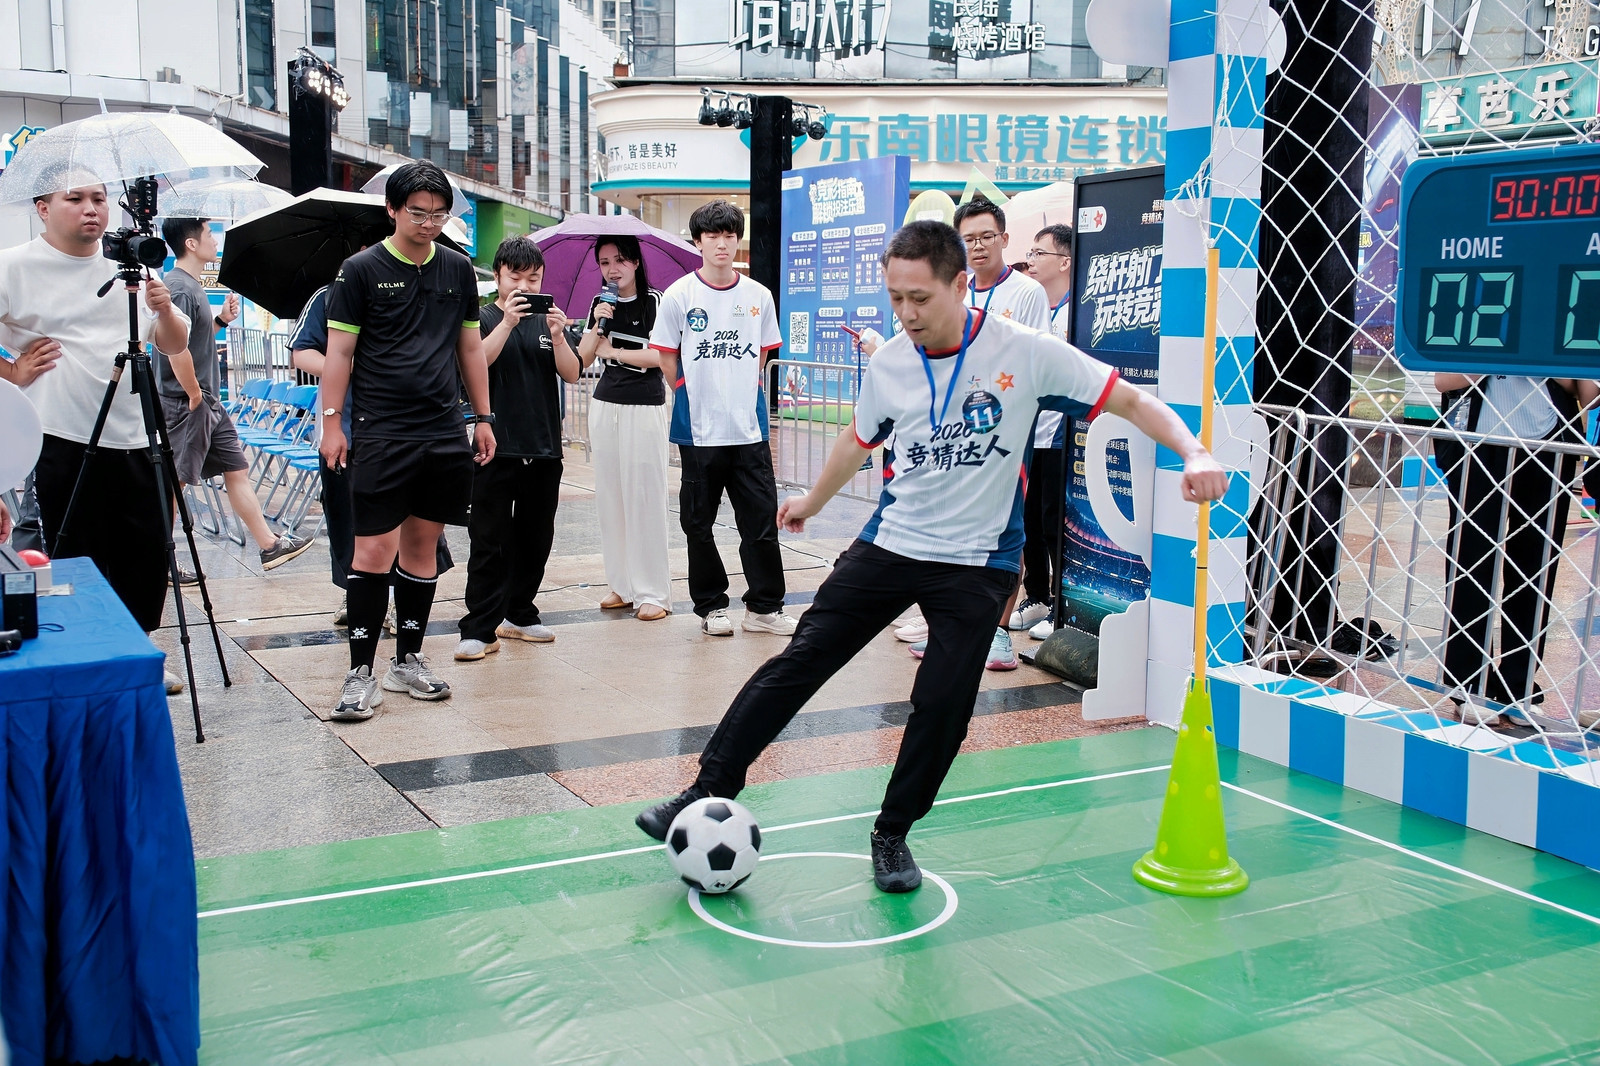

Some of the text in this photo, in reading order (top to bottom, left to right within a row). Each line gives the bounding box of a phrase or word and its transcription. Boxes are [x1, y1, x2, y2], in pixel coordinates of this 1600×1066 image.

[951, 22, 1045, 51] 烧烤酒馆
[1423, 70, 1574, 133] 草芭乐
[819, 113, 1167, 164] 东南眼镜连锁
[648, 161, 678, 170] BEAUTY
[1494, 173, 1600, 220] 90:00
[1441, 236, 1503, 260] HOME
[378, 281, 405, 289] KELME
[1425, 272, 1515, 347] 02
[690, 317, 705, 329] 20
[713, 330, 739, 342] 2026
[693, 339, 758, 361] 竞猜达人
[970, 406, 995, 428] 11
[903, 434, 1011, 473] 竞猜达人
